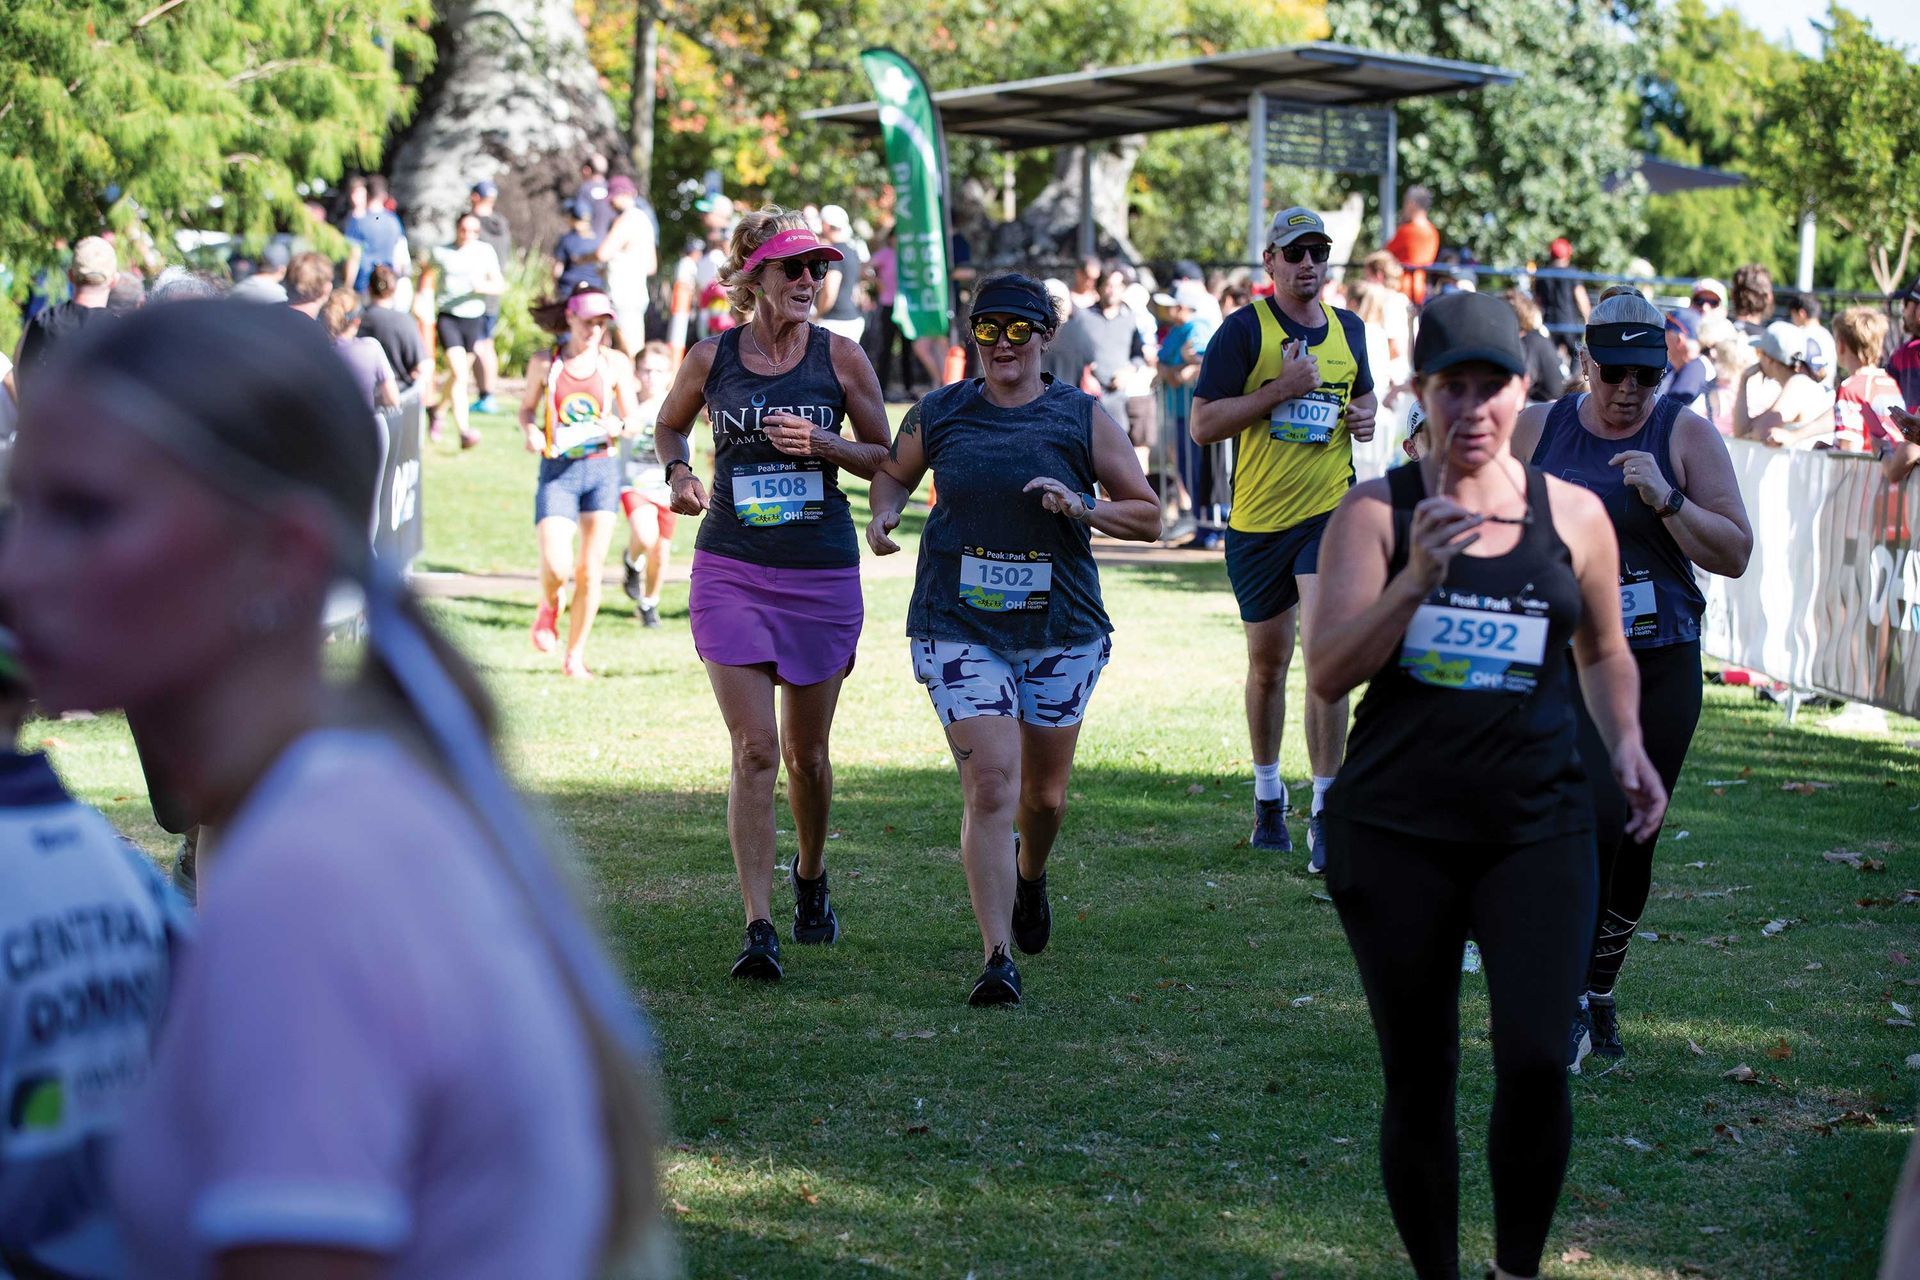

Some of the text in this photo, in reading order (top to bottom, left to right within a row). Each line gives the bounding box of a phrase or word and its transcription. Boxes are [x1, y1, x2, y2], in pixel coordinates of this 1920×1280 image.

[1287, 402, 1331, 422] 1007
[736, 434, 756, 445] AM
[757, 462, 797, 473] Peak2Park
[751, 477, 808, 499] 1508
[783, 511, 803, 521] OH!
[986, 550, 1026, 561] Peak2Park
[979, 564, 1034, 587] 1502
[1005, 600, 1027, 610] OH!
[1432, 615, 1519, 652] 2592
